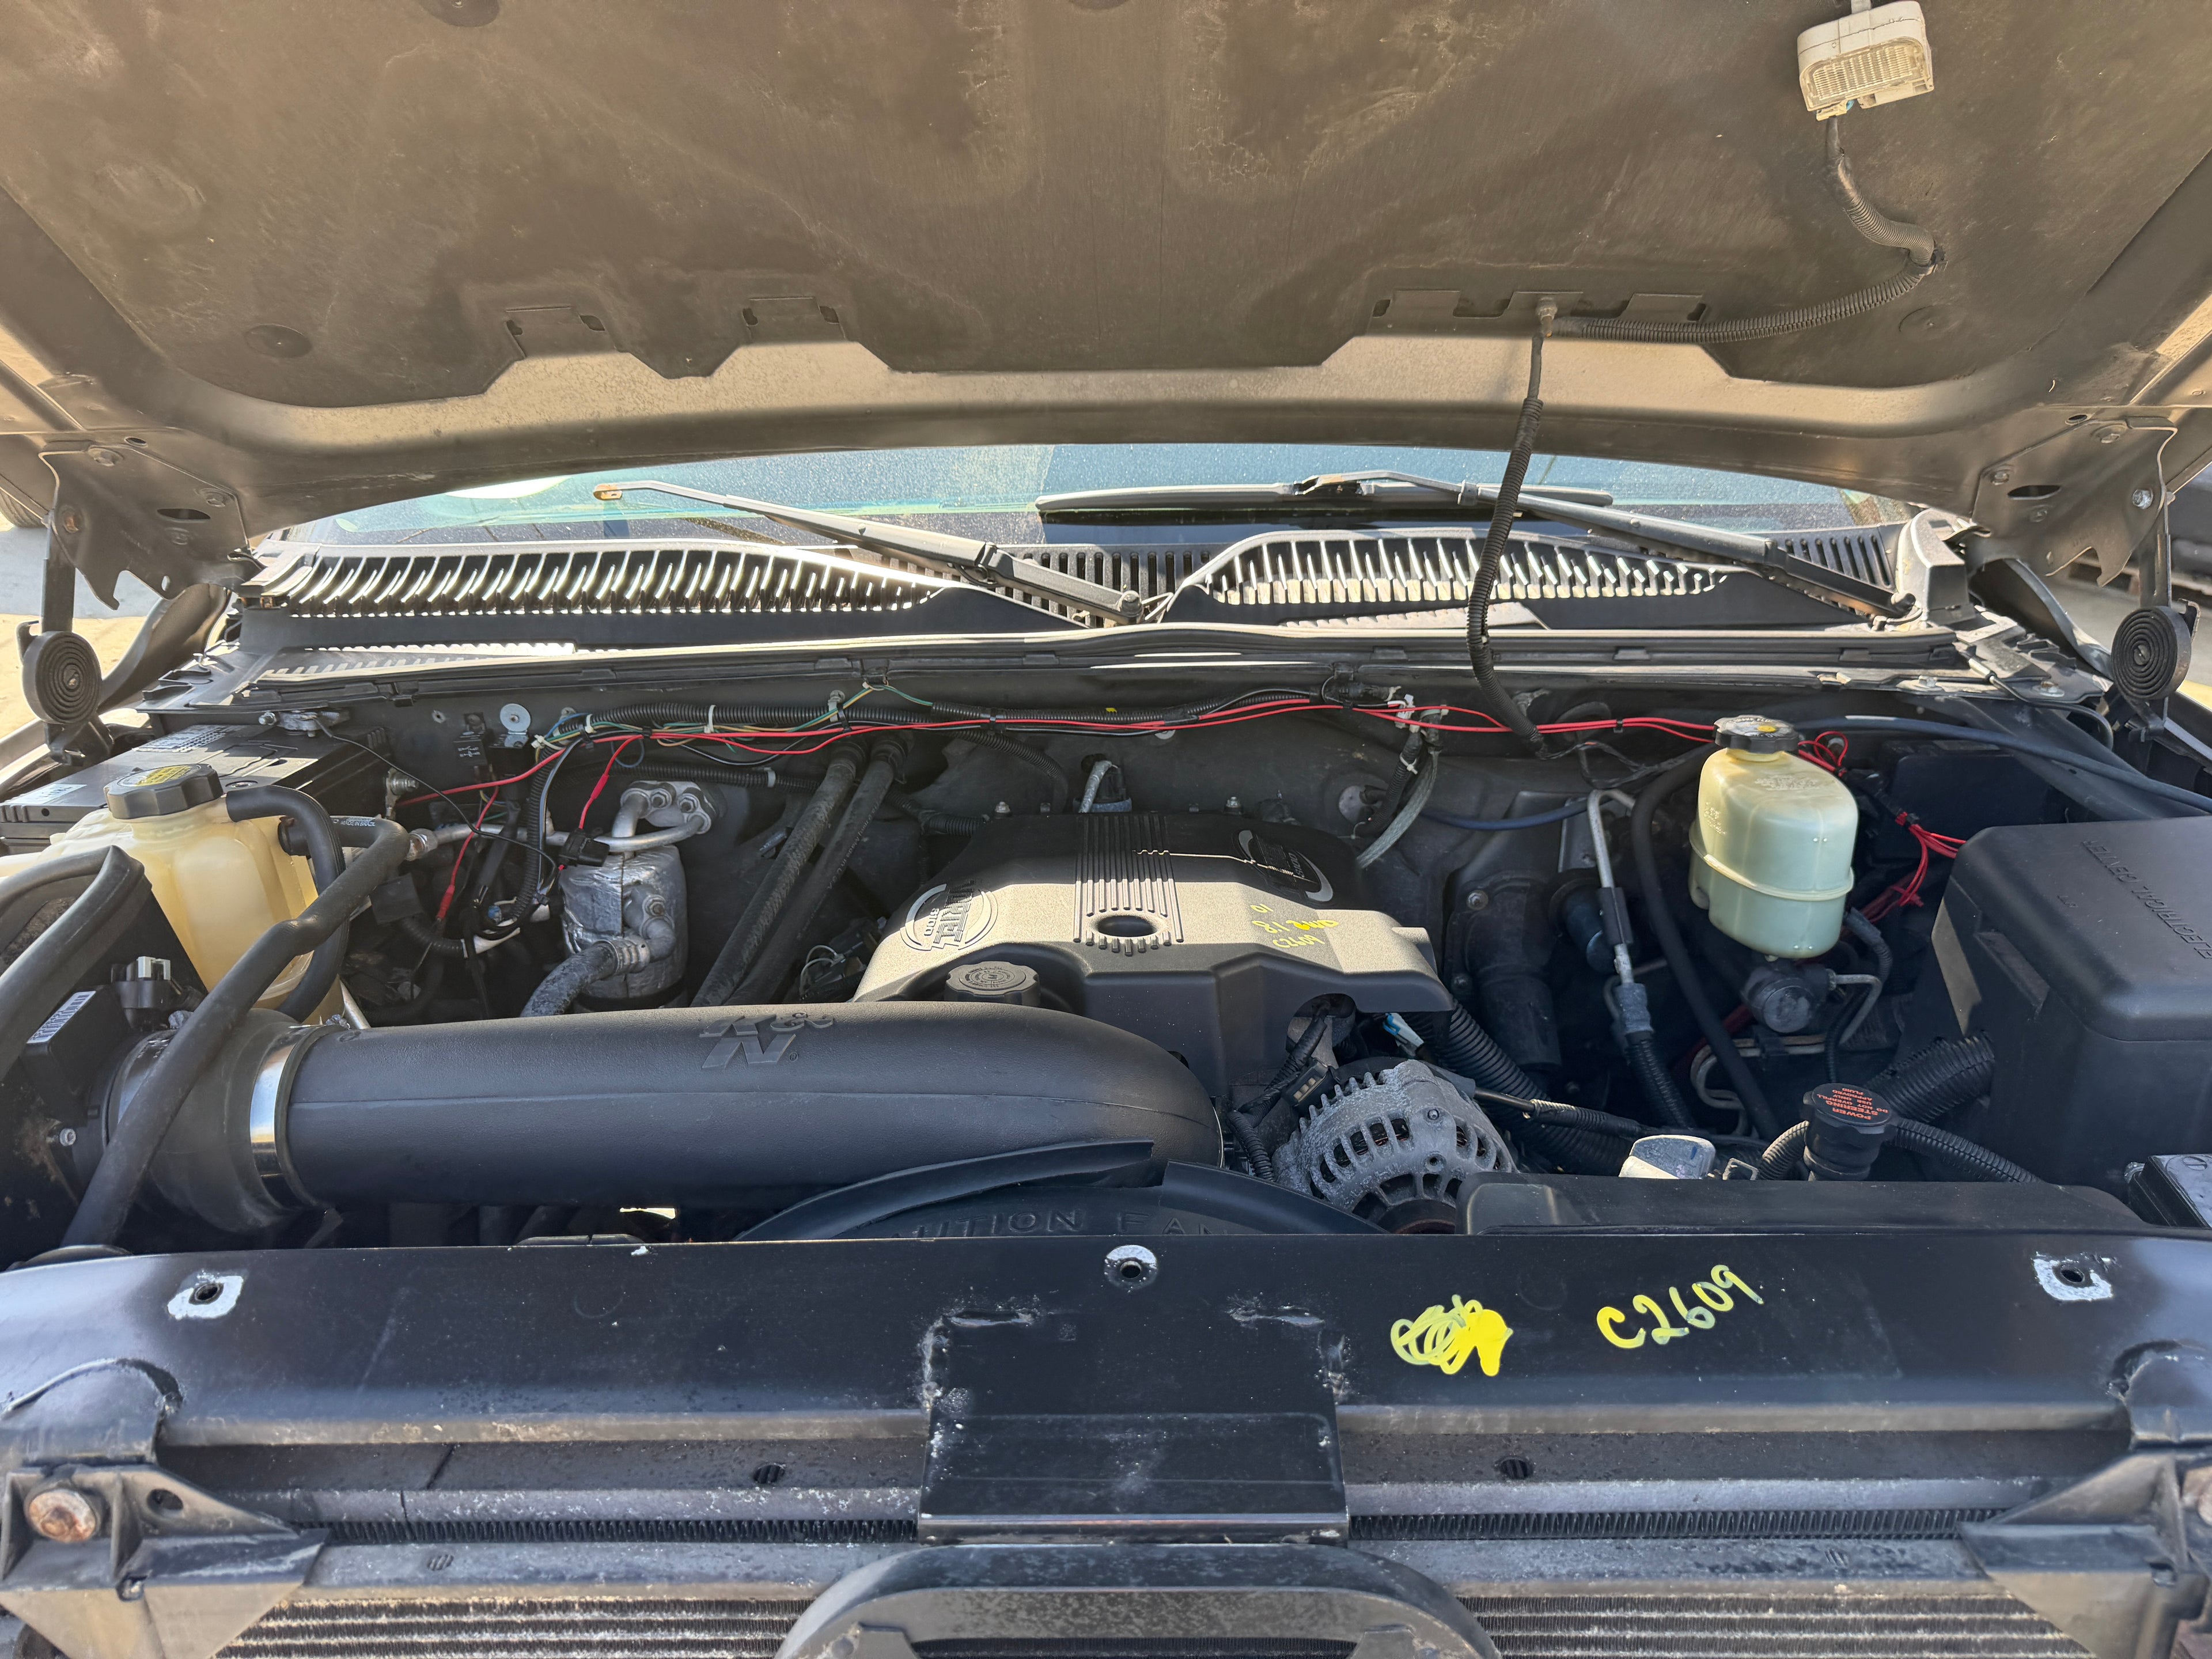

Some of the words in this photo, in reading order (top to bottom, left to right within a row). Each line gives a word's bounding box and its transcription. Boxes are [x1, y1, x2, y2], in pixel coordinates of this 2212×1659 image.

[846, 836, 860, 858] Made
[2081, 840, 2142, 883] CENTER
[1251, 920, 1291, 934] 8.1
[2131, 885, 2212, 959] ELECTRICAL
[1272, 934, 1325, 949] C2609
[1832, 1089, 1873, 1101] APPROVED
[1842, 1088, 1864, 1096] FLUID
[1816, 1094, 1853, 1106] OVERFILL
[1825, 1100, 1878, 1116] STEERING
[1832, 1107, 1872, 1121] POWER
[1596, 1264, 1764, 1349] C2609
